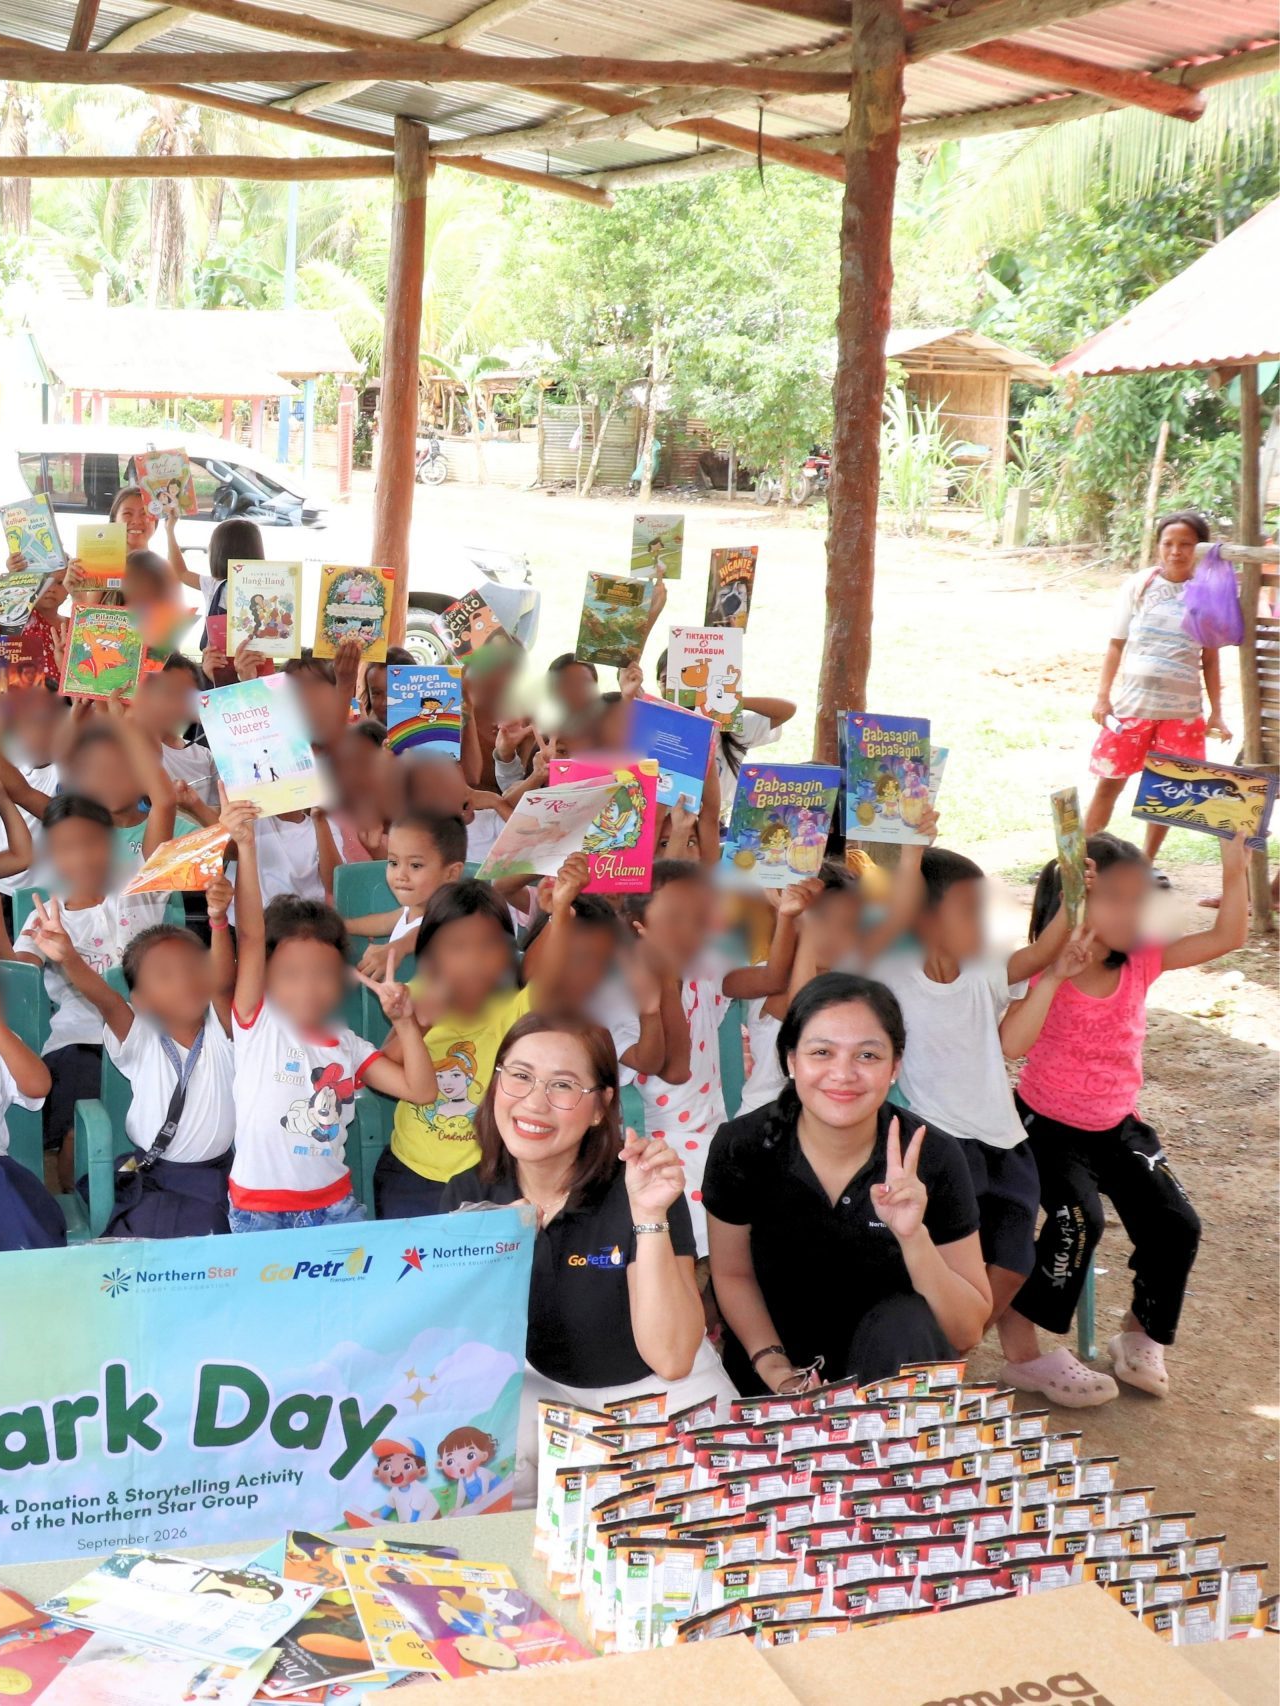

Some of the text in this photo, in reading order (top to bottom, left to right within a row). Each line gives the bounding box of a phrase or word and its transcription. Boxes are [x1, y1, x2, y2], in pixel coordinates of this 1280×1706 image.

[392, 681, 457, 692] Color Came
[410, 674, 440, 684] When
[402, 689, 447, 699] to Town
[222, 706, 270, 724] Dancing
[229, 720, 271, 736] Waters
[867, 743, 921, 760] Babasagin
[756, 793, 823, 809] Babasagin
[594, 853, 645, 879] Adarna
[287, 1048, 305, 1060] It's
[273, 1070, 305, 1086] about
[193, 1363, 397, 1481] Day
[15, 1495, 100, 1514] Donation
[106, 1491, 119, 1505] &
[125, 1479, 230, 1503] Storytelling
[236, 1469, 304, 1488] Activity
[10, 1492, 259, 1531] of the Northern Star Group
[77, 1527, 188, 1551] September 2026
[631, 1569, 648, 1577] Fres
[726, 1588, 745, 1596] Fresh
